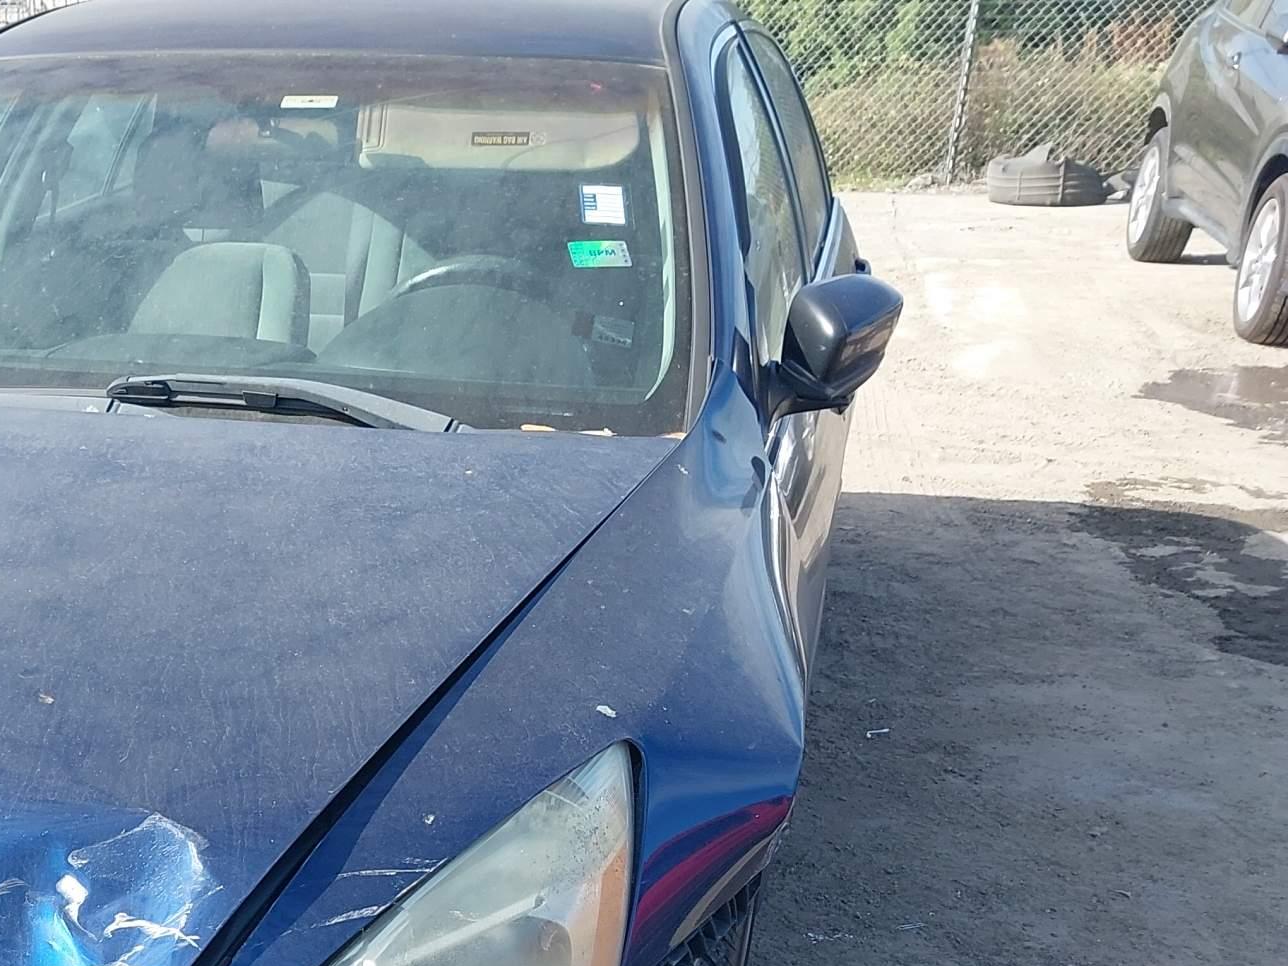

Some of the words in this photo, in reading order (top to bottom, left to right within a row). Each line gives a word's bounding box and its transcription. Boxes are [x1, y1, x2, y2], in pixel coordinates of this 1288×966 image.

[474, 135, 502, 144] WARNING
[502, 135, 516, 144] BAG
[516, 135, 528, 144] AIR
